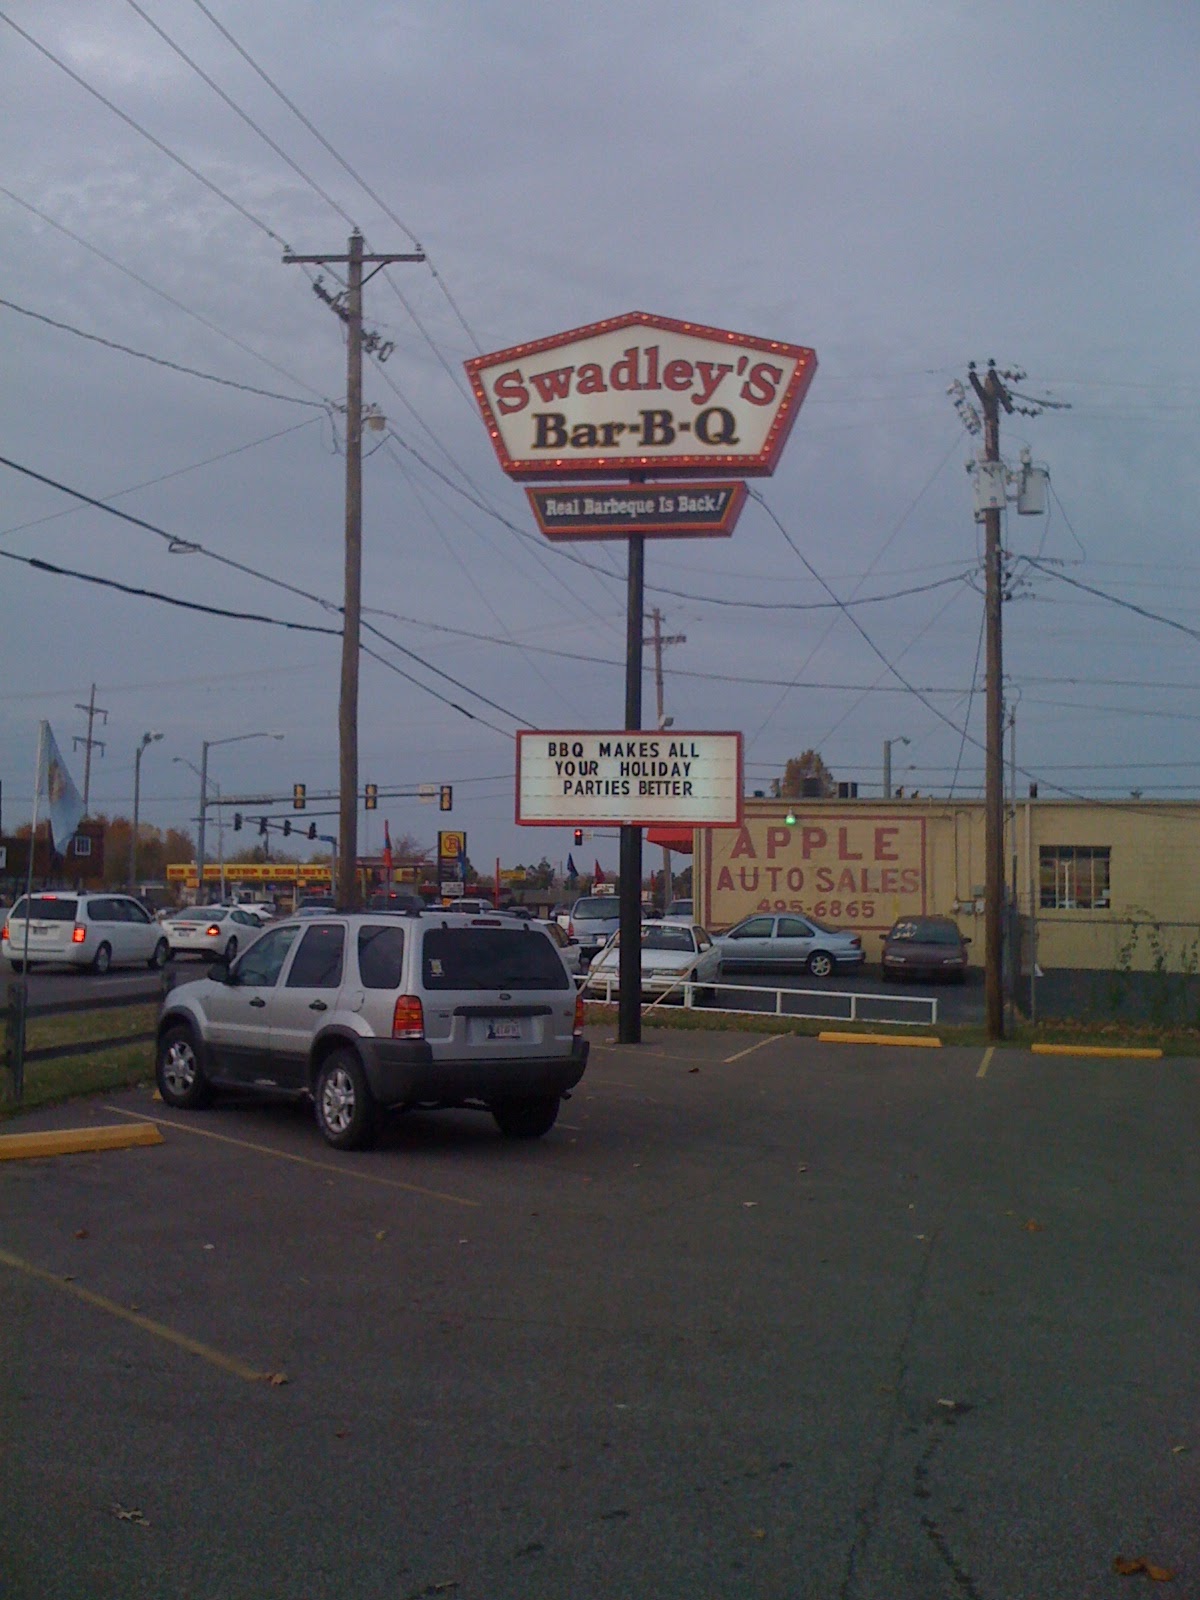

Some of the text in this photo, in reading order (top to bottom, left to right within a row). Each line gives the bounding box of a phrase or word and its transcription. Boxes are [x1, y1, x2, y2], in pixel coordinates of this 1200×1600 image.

[531, 407, 740, 450] Bar-B-Q
[546, 492, 726, 518] Real Barbeque Is Back!
[548, 742, 700, 758] BBQ MAKES ALL
[555, 760, 692, 777] YOUR HOLIDAY
[563, 780, 693, 796] PARTIES BETTER
[730, 826, 900, 861] APPLE
[717, 866, 920, 894] AUTO SALES
[757, 899, 876, 918] 495-6865
